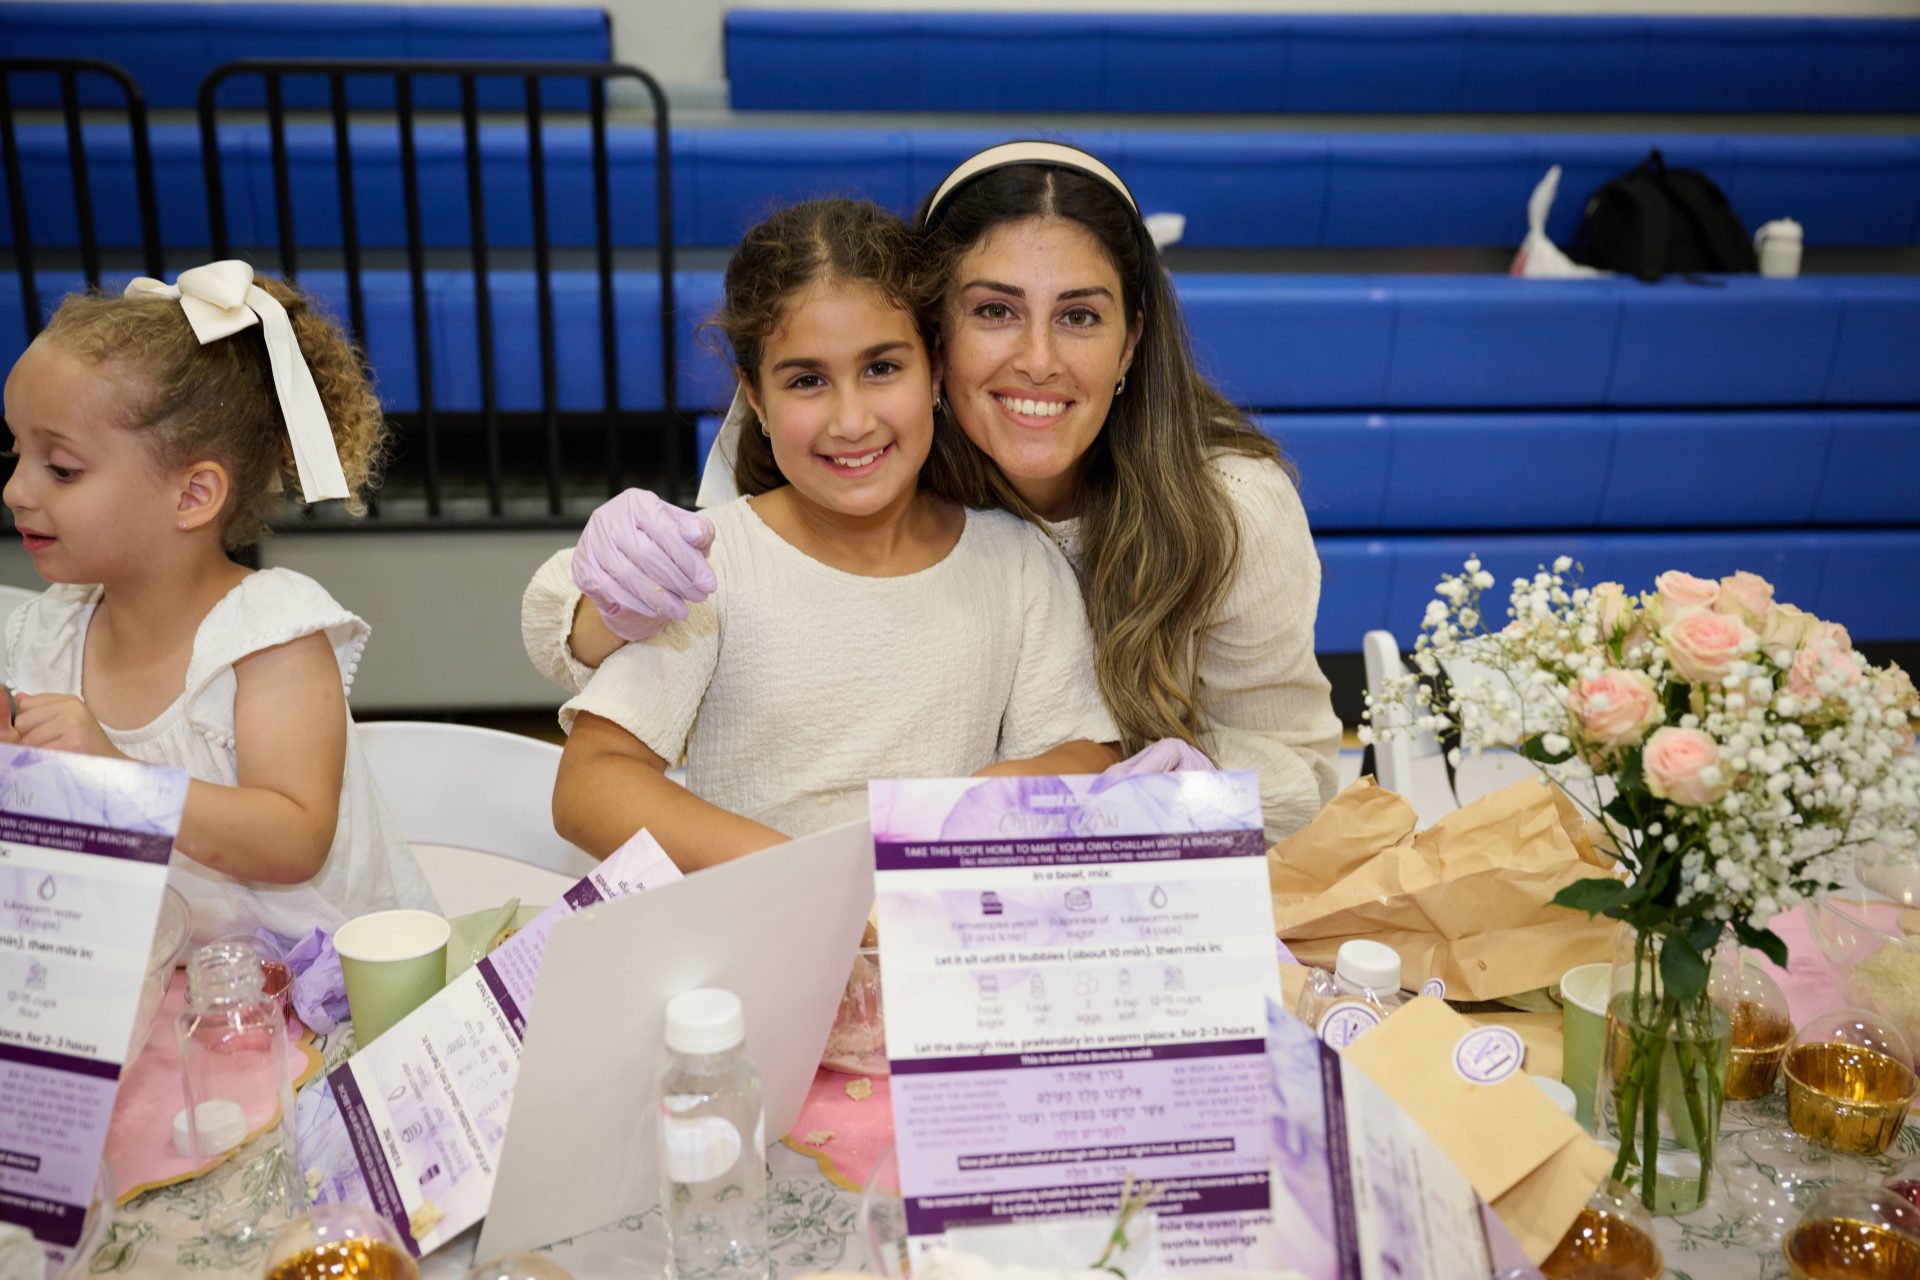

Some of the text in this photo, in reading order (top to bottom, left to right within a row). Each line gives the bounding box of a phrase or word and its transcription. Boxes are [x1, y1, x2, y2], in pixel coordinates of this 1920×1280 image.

[18, 820, 61, 836] CHALLAH
[62, 825, 88, 840] WITH
[88, 831, 96, 842] A
[905, 837, 1190, 858] TAKE THIS RECIPE HOME TO MAKE YOUR OWN CHALLAH WITH A
[1033, 871, 1044, 880] In
[1056, 869, 1085, 880] bowl,
[1088, 867, 1113, 878] mix:
[1172, 912, 1199, 921] water
[28, 939, 54, 953] then
[56, 945, 77, 957] mix
[935, 955, 951, 966] Let
[965, 954, 977, 964] sit
[980, 952, 1005, 963] until
[1018, 949, 1064, 961] bubbles
[1067, 947, 1106, 962] (about
[1109, 947, 1119, 957] 10
[1156, 946, 1182, 956] then
[1184, 943, 1206, 953] mix
[1208, 941, 1222, 952] in:
[26, 1031, 42, 1043] for
[65, 1038, 97, 1053] hours
[915, 1025, 1255, 1056] Let the dough rise, preferably in a warm place, for 2-3 hours
[1021, 1054, 1038, 1065] This
[1039, 1053, 1047, 1064] is
[1048, 1052, 1074, 1064] where
[1075, 1051, 1090, 1062] the
[1122, 1049, 1130, 1060] is
[1060, 1149, 1087, 1163] dough
[1088, 1148, 1107, 1159] with
[1108, 1149, 1129, 1159] your
[1130, 1145, 1149, 1158] right
[1178, 1142, 1195, 1152] and
[919, 1198, 934, 1208] The
[935, 1196, 970, 1207] moment
[1184, 1219, 1204, 1230] the
[1207, 1219, 1237, 1229] oven
[1203, 1235, 1257, 1249] toppings
[1179, 1251, 1233, 1267] browned
